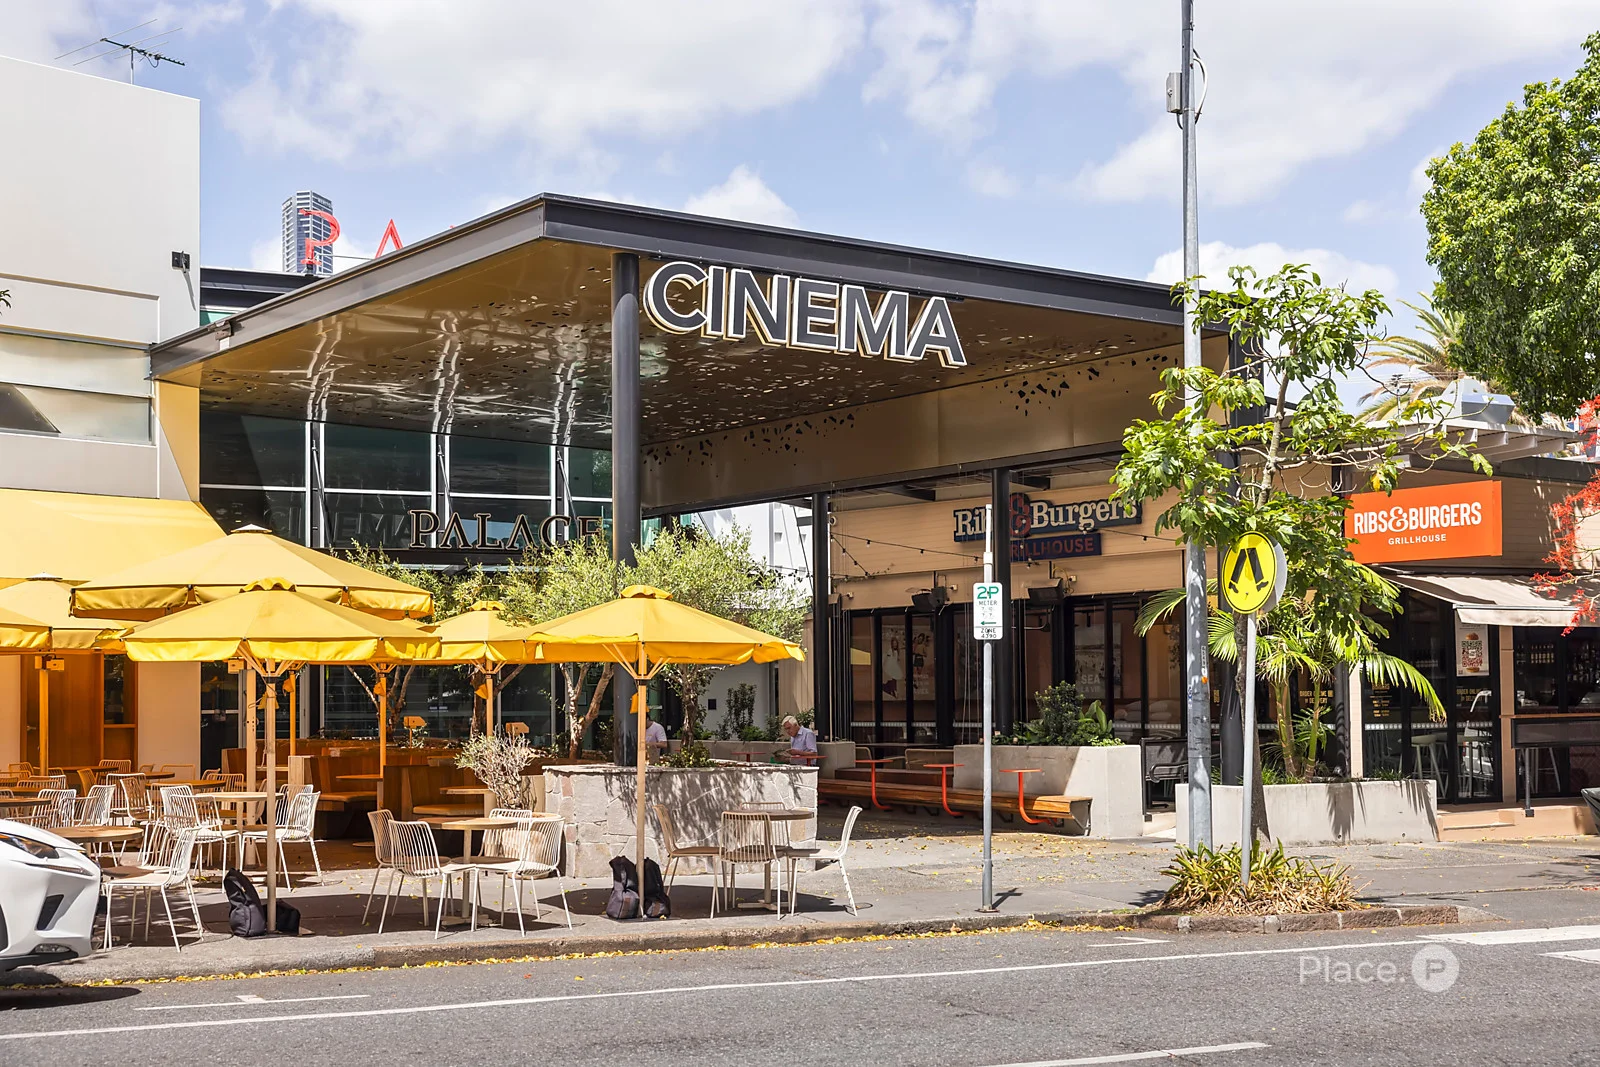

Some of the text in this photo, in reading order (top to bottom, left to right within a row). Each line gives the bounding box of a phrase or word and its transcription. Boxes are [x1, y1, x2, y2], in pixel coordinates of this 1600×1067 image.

[643, 261, 967, 368] CINEMA
[1010, 537, 1094, 559] RILLHOUSE
[1388, 533, 1447, 546] GRILLHOUSE
[976, 586, 1000, 600] 2P
